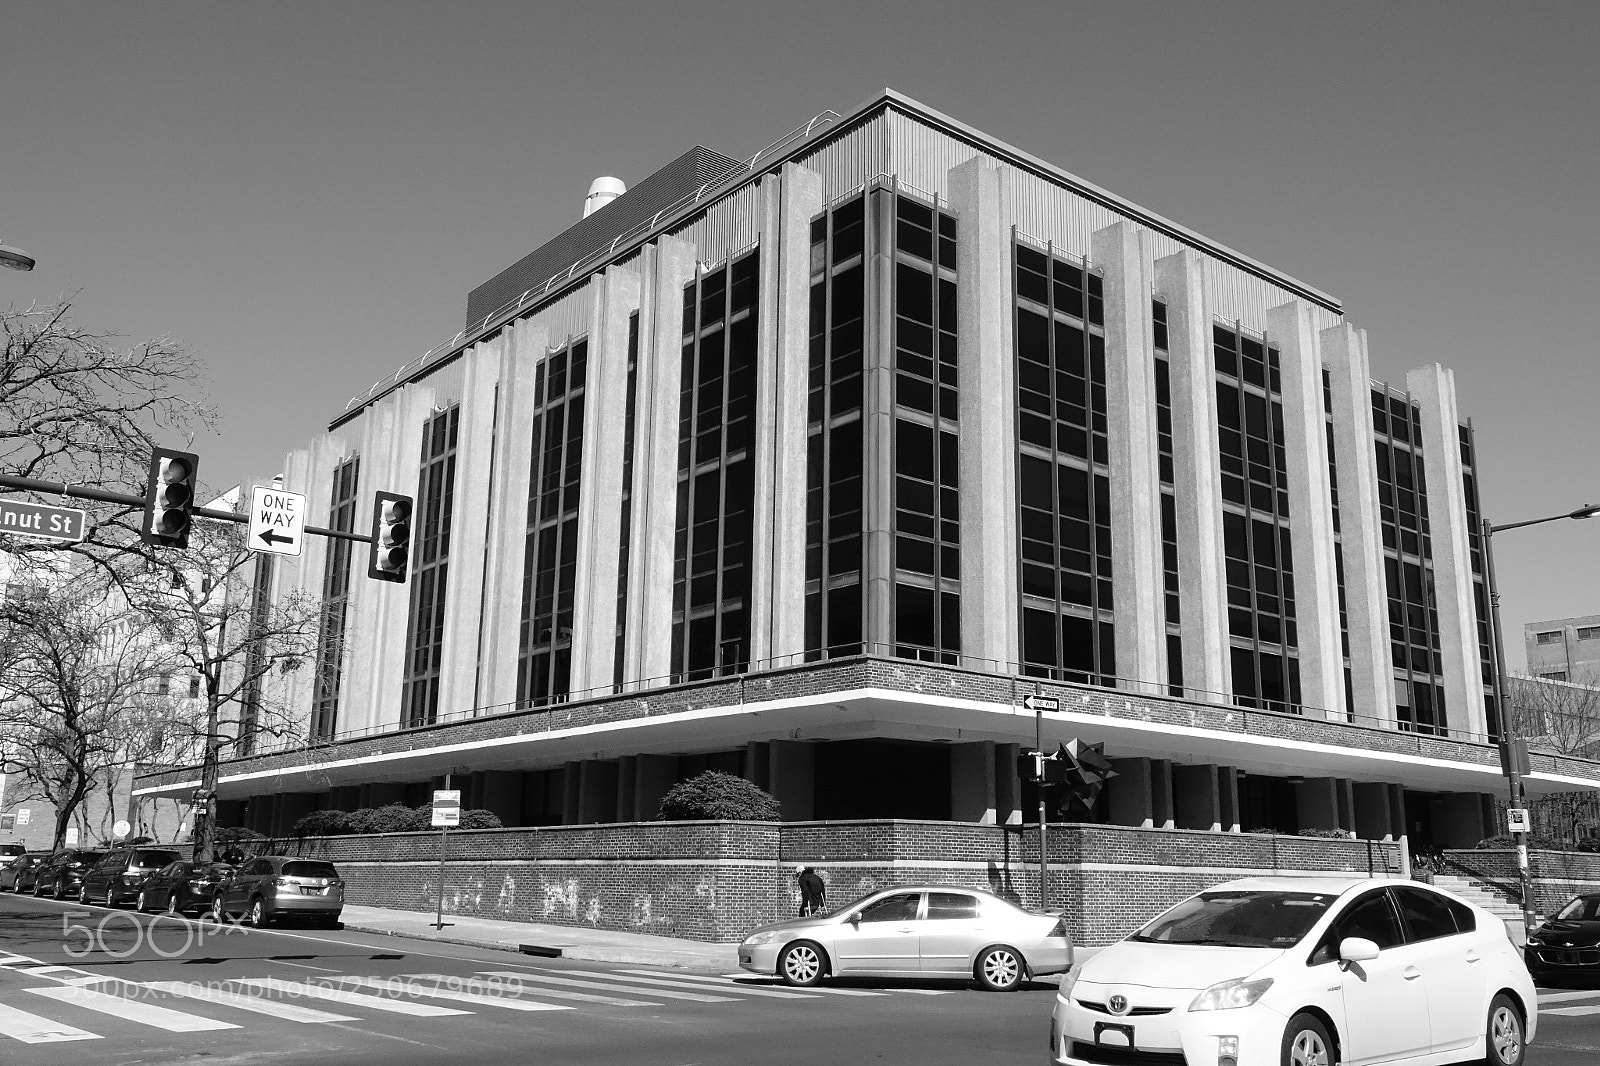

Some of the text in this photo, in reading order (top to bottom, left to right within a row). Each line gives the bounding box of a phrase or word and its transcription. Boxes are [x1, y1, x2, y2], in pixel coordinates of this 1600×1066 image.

[263, 494, 295, 512] ONE
[49, 513, 72, 534] St
[261, 509, 295, 528] WAY
[1033, 699, 1044, 707] ONE
